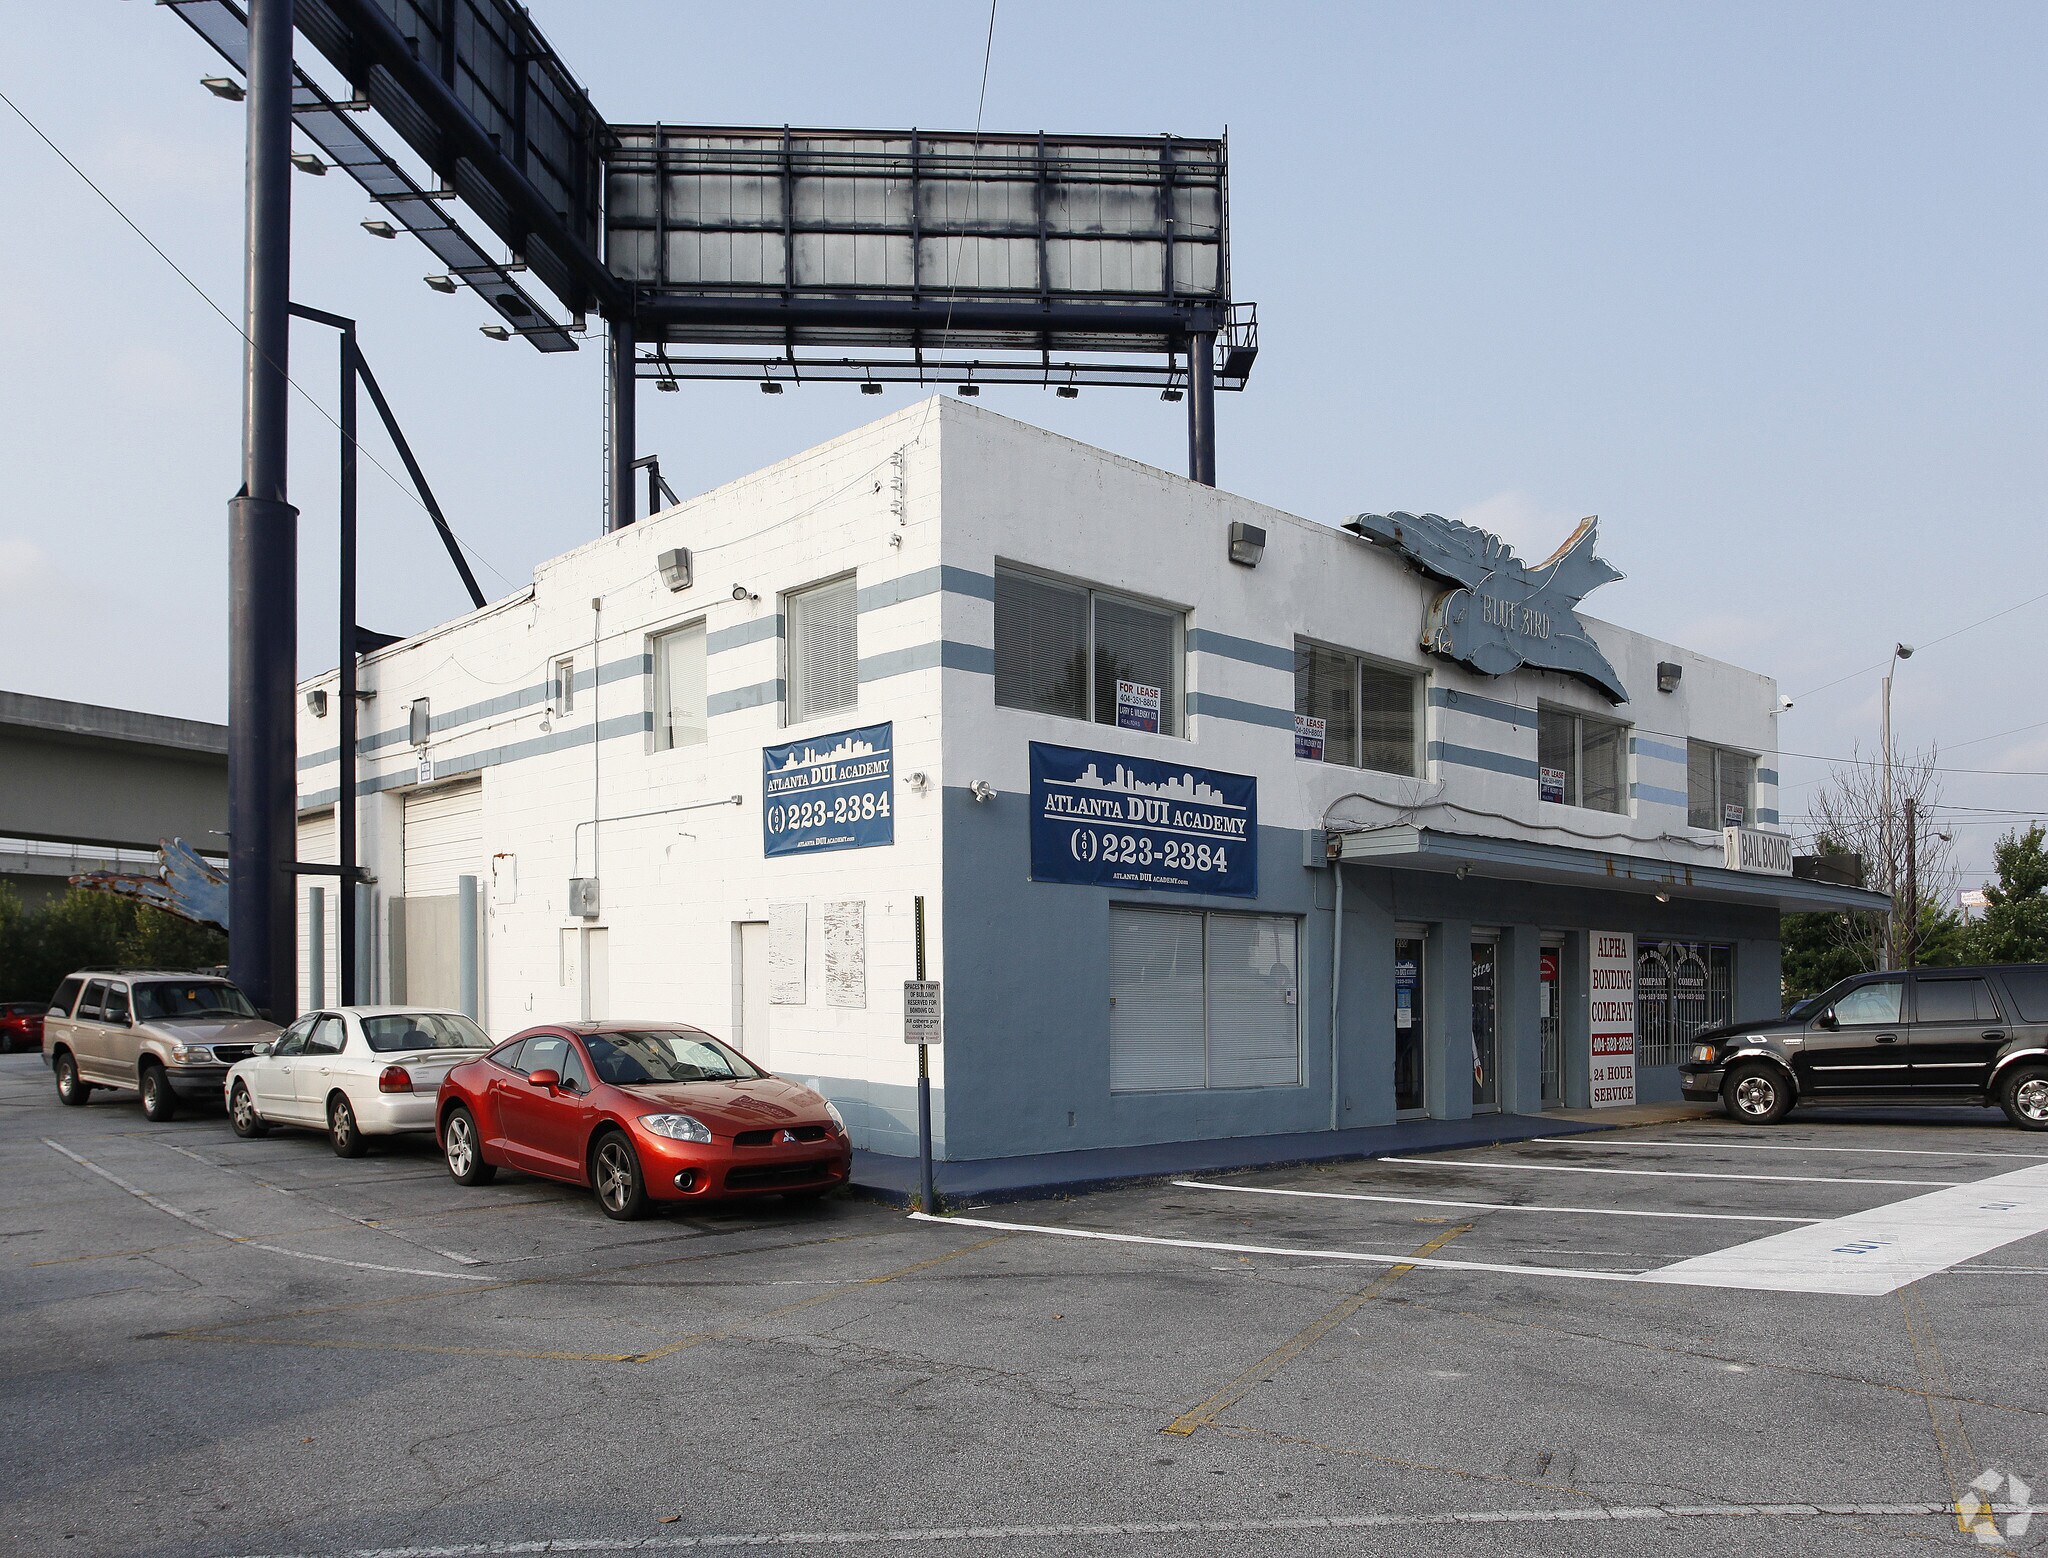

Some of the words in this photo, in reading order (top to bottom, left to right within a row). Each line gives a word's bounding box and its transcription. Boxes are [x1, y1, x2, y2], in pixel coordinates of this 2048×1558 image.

[1483, 595, 1516, 631] BLUE
[1520, 607, 1550, 639] BIRD
[1119, 682, 1134, 694] FOR
[1136, 686, 1159, 699] LEASE
[1306, 718, 1325, 730] LEASE
[767, 774, 809, 792] ATLANTA
[810, 763, 838, 785] DUI
[838, 759, 890, 780] ACADEMY
[788, 790, 891, 830] 223-2384
[1044, 793, 1124, 819] ATLANTA
[1127, 797, 1170, 825] DUI
[1172, 810, 1247, 835] ACADEMY
[815, 836, 827, 846] DUI
[1102, 833, 1228, 873] 223-2384
[1742, 833, 1762, 868] BAIL
[1762, 837, 1792, 872] BONDS
[1113, 872, 1139, 881] ATLANTA
[1139, 872, 1152, 882] DUI
[1152, 876, 1189, 886] ACADEMY.com
[1597, 936, 1628, 959] ALPHA
[1592, 969, 1632, 990] BONDING
[1638, 977, 1667, 986] COMPANY
[1678, 978, 1705, 987] COMPANY
[1591, 1001, 1634, 1022] COMPANY
[1593, 1068, 1605, 1081] 24
[1607, 1065, 1633, 1081] HOUR
[1594, 1085, 1634, 1103] SERVICE
